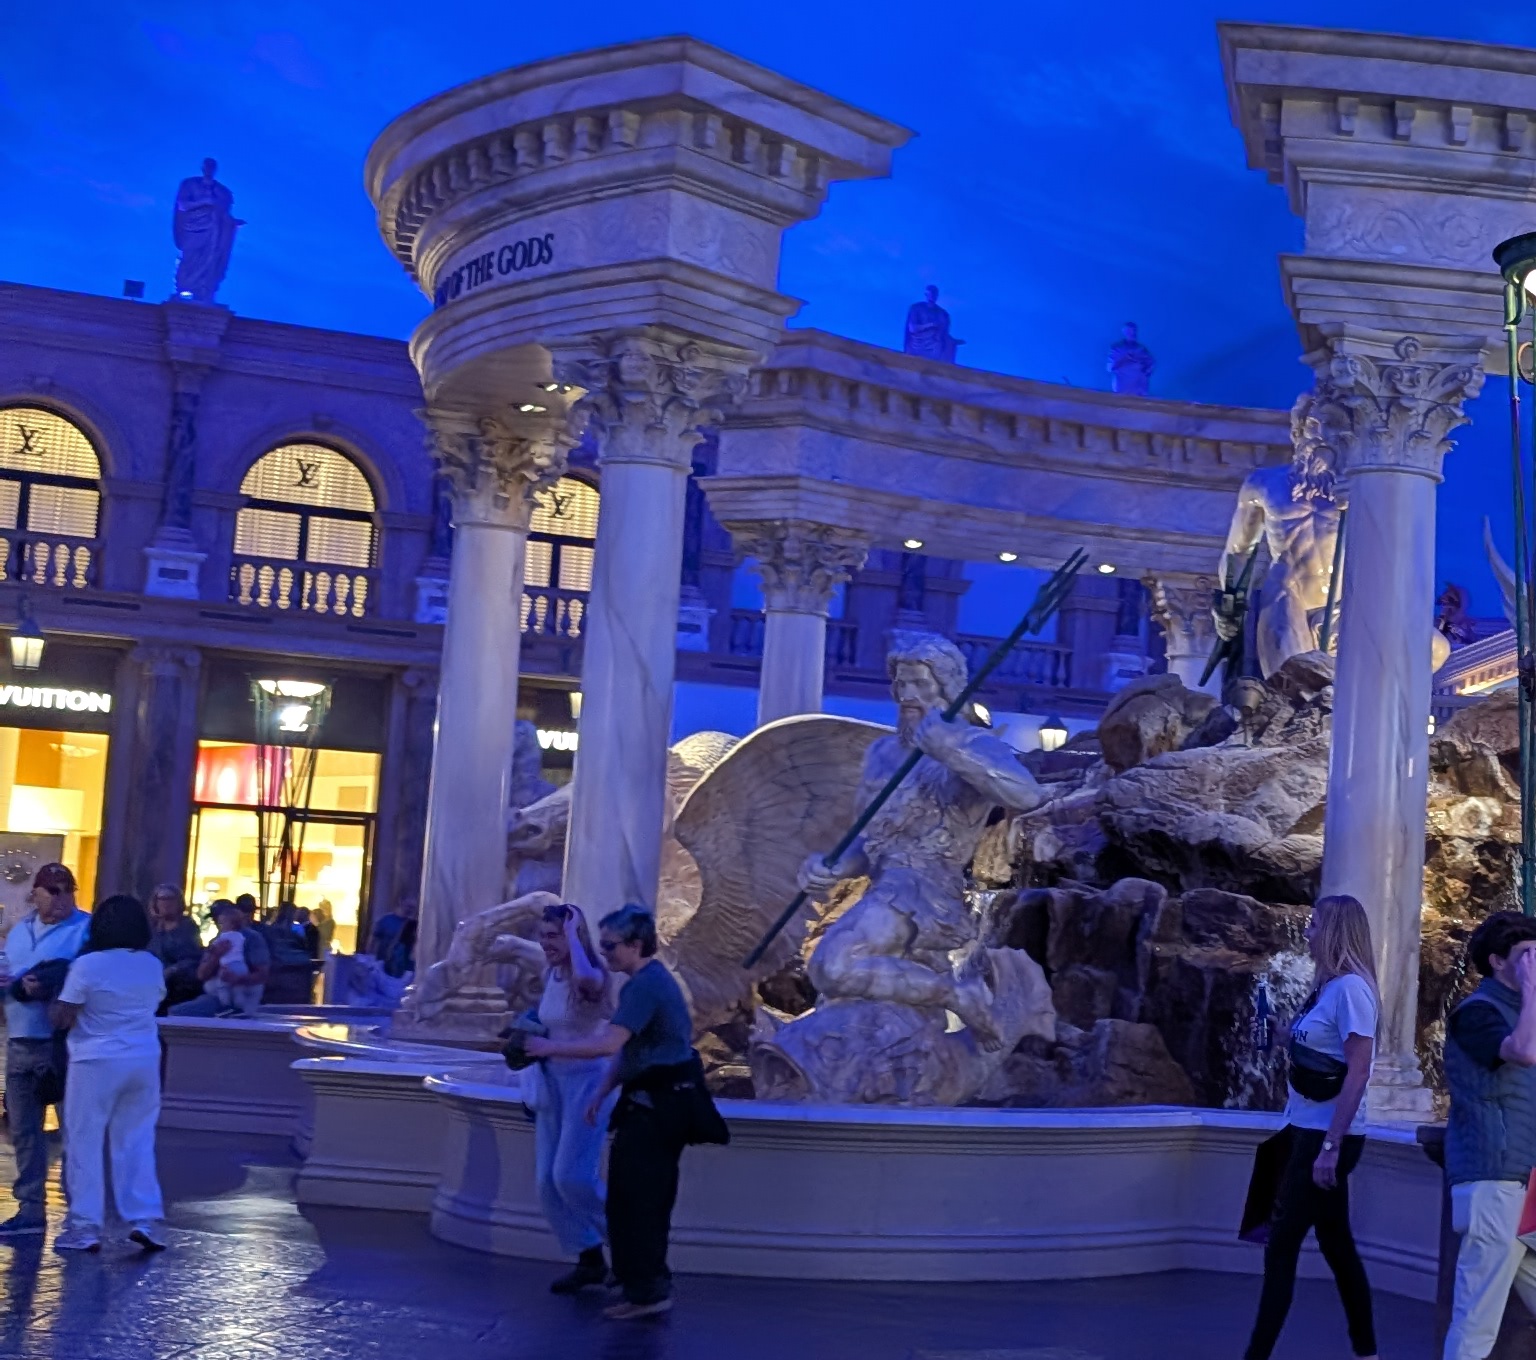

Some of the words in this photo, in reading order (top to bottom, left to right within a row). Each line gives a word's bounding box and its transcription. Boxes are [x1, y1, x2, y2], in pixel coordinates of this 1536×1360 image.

[466, 251, 494, 290] THE
[497, 233, 555, 275] GODS
[0, 685, 112, 713] VUITTON
